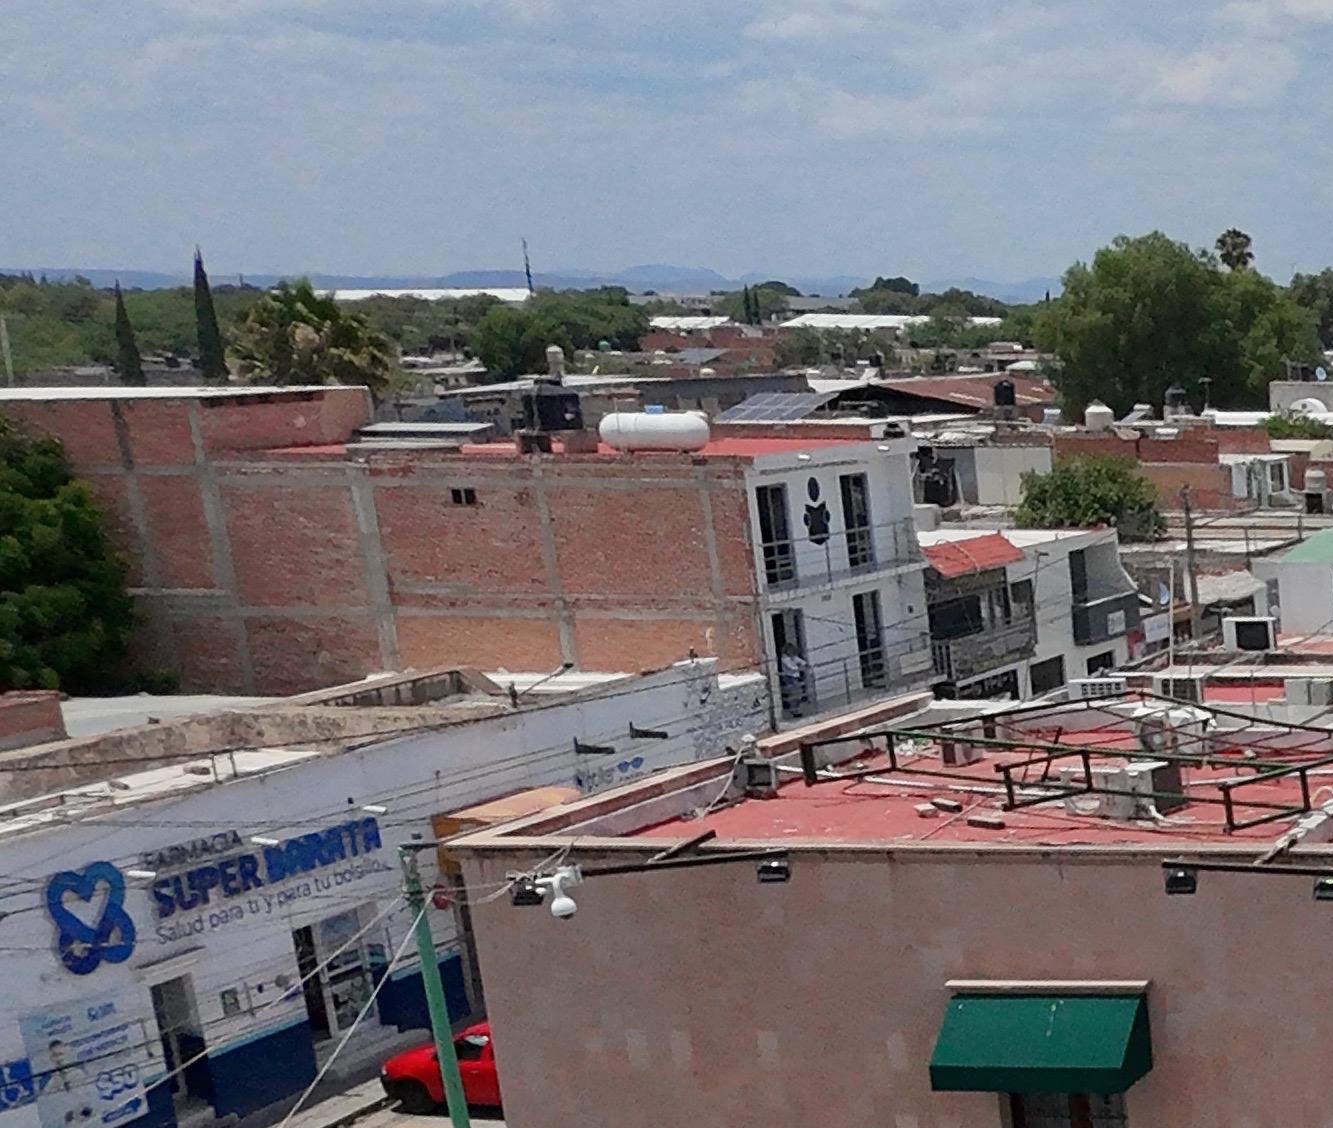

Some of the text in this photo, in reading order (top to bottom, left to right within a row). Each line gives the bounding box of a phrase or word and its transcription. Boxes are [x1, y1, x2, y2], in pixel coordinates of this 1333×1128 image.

[143, 829, 243, 867] FARMACIA
[153, 816, 382, 920] SUPER BARATA
[155, 915, 204, 944] Salud
[208, 904, 244, 928] para
[260, 897, 274, 914] y
[277, 881, 312, 909] para
[315, 875, 332, 892] tu
